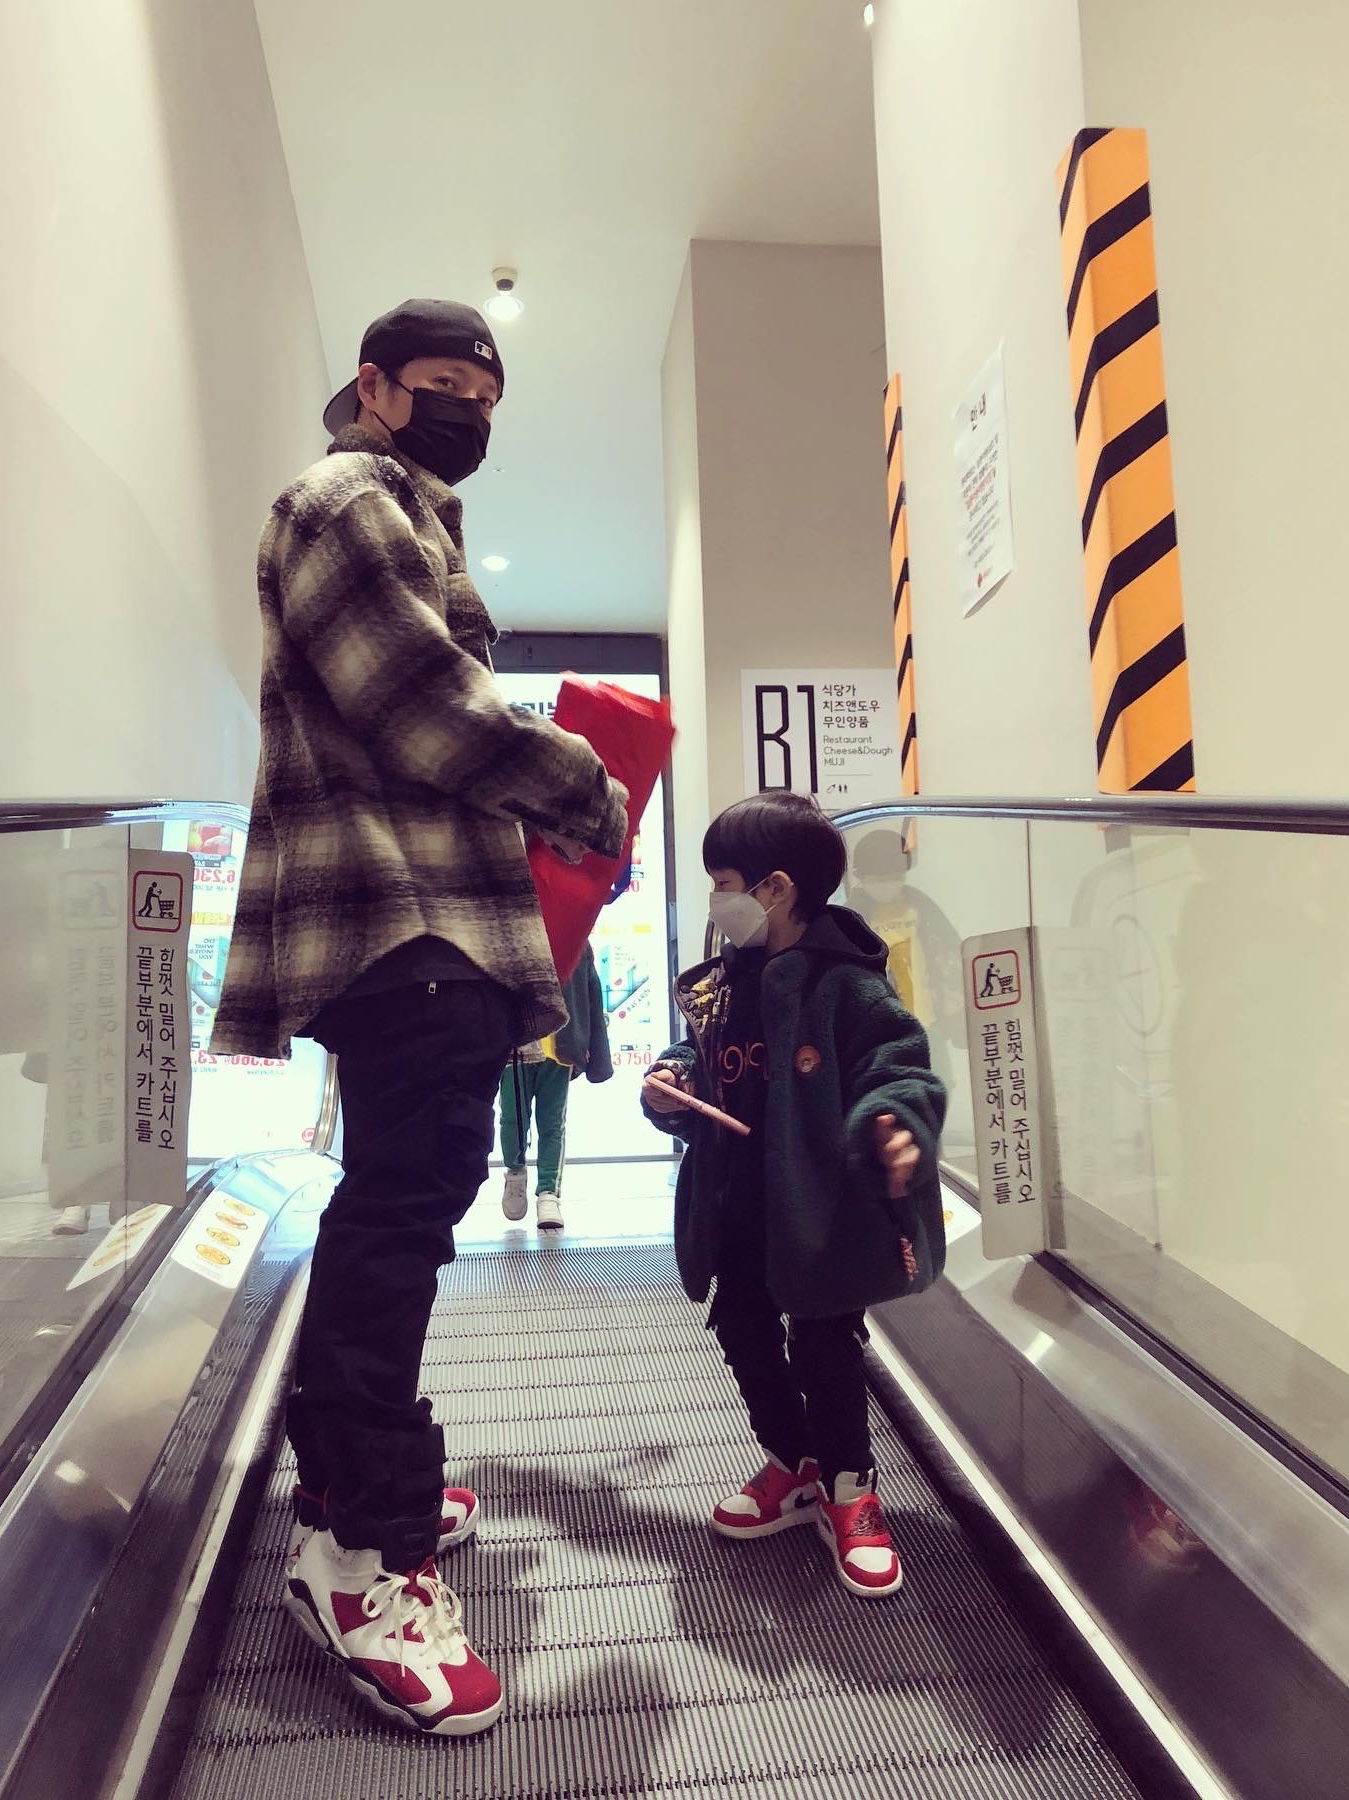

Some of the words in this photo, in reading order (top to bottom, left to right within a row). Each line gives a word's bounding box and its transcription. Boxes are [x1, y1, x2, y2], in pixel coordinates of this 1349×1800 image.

[821, 684, 857, 697] 식당가
[822, 700, 880, 713] 치즈앤도우
[755, 684, 819, 794] B1
[822, 715, 869, 729] 무인양품
[823, 734, 873, 744] Restaurant
[823, 746, 894, 757] Cheese&Dough
[823, 757, 846, 767] MUJI
[158, 947, 176, 997] 힘껏
[136, 945, 155, 1066] 끝부분에서
[158, 1002, 176, 1051] 밀어
[1004, 1018, 1024, 1064] 힘껏
[157, 1055, 179, 1150] 주십시오
[981, 1023, 1007, 1133] 끝부분에서
[1008, 1068, 1028, 1112] 밀어
[135, 1072, 155, 1144] 카트를
[990, 1140, 1013, 1205] 카트를
[1012, 1117, 1036, 1204] 주십시오
